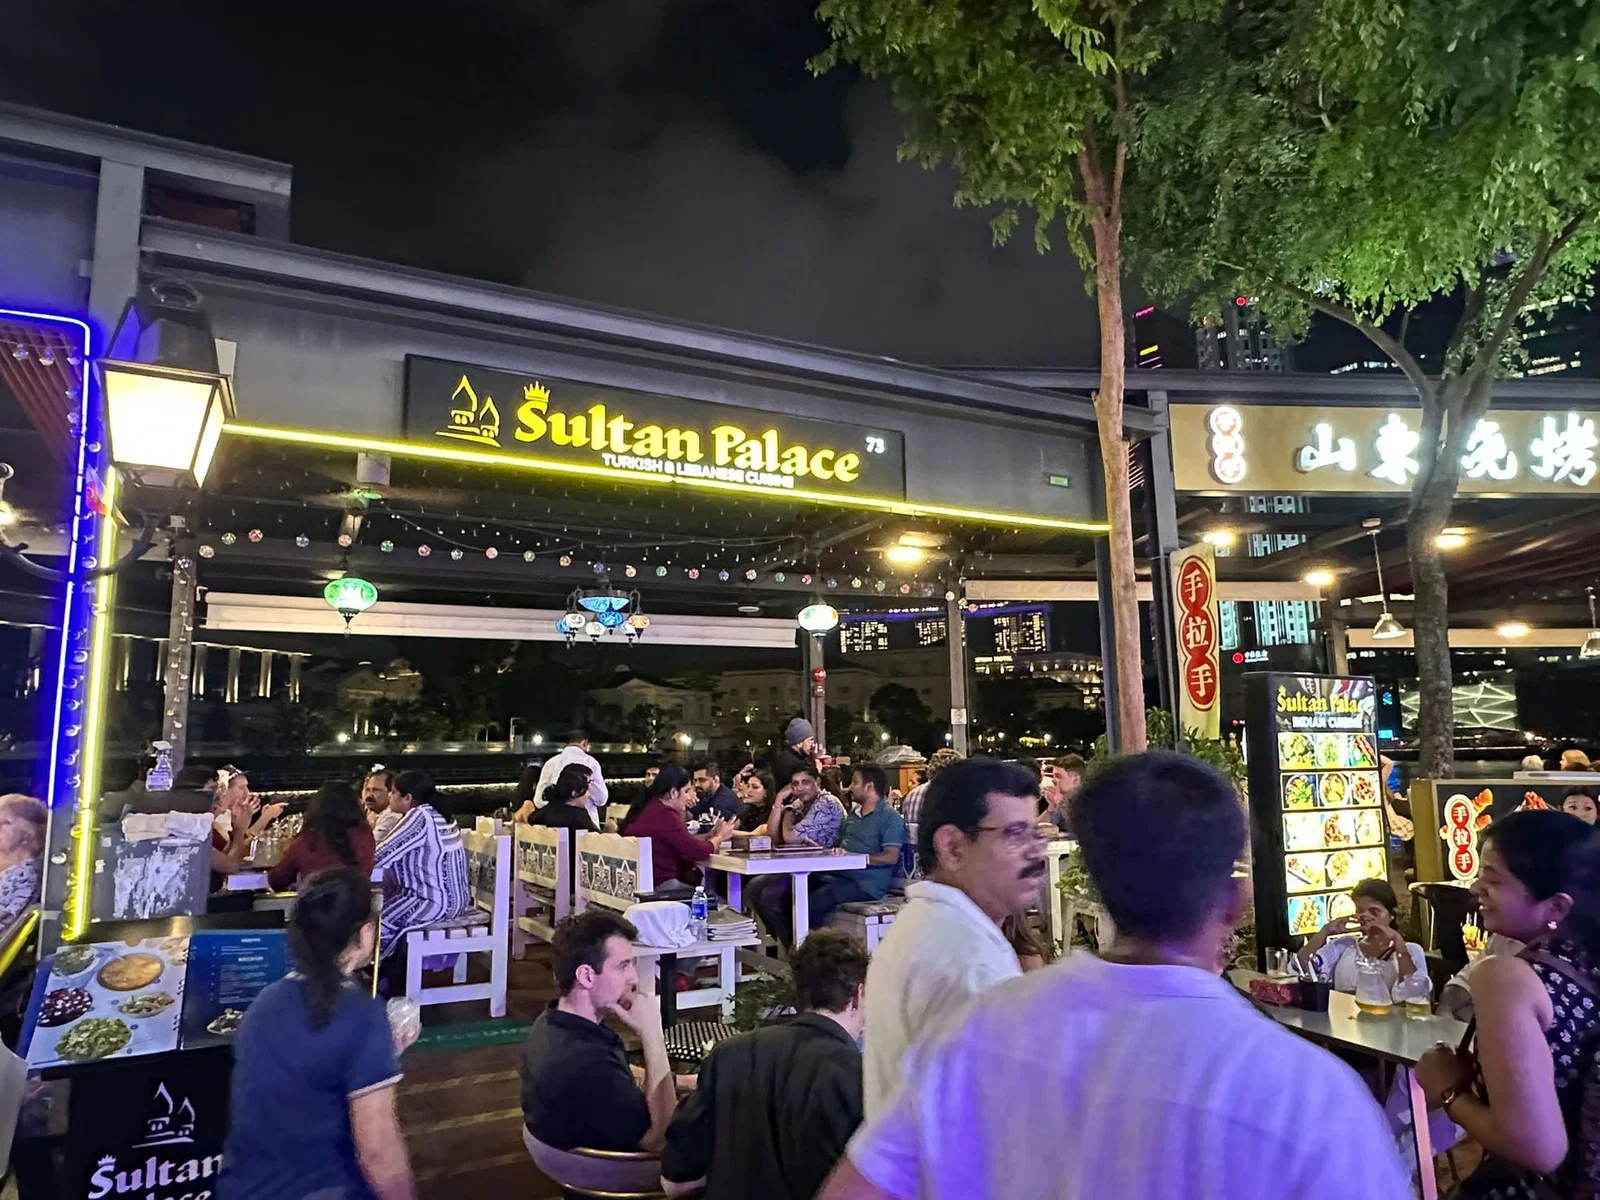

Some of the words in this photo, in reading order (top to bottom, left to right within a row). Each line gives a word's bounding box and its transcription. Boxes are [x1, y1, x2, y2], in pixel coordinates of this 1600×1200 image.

[514, 399, 705, 463] Sultan
[711, 425, 860, 482] Palace
[602, 453, 663, 473] TURKISH
[865, 436, 885, 454] 73
[1184, 568, 1213, 698] 手拉手
[1277, 691, 1328, 712] Sultan
[1452, 804, 1473, 871] 手拉手
[88, 1154, 225, 1199] Sultan
